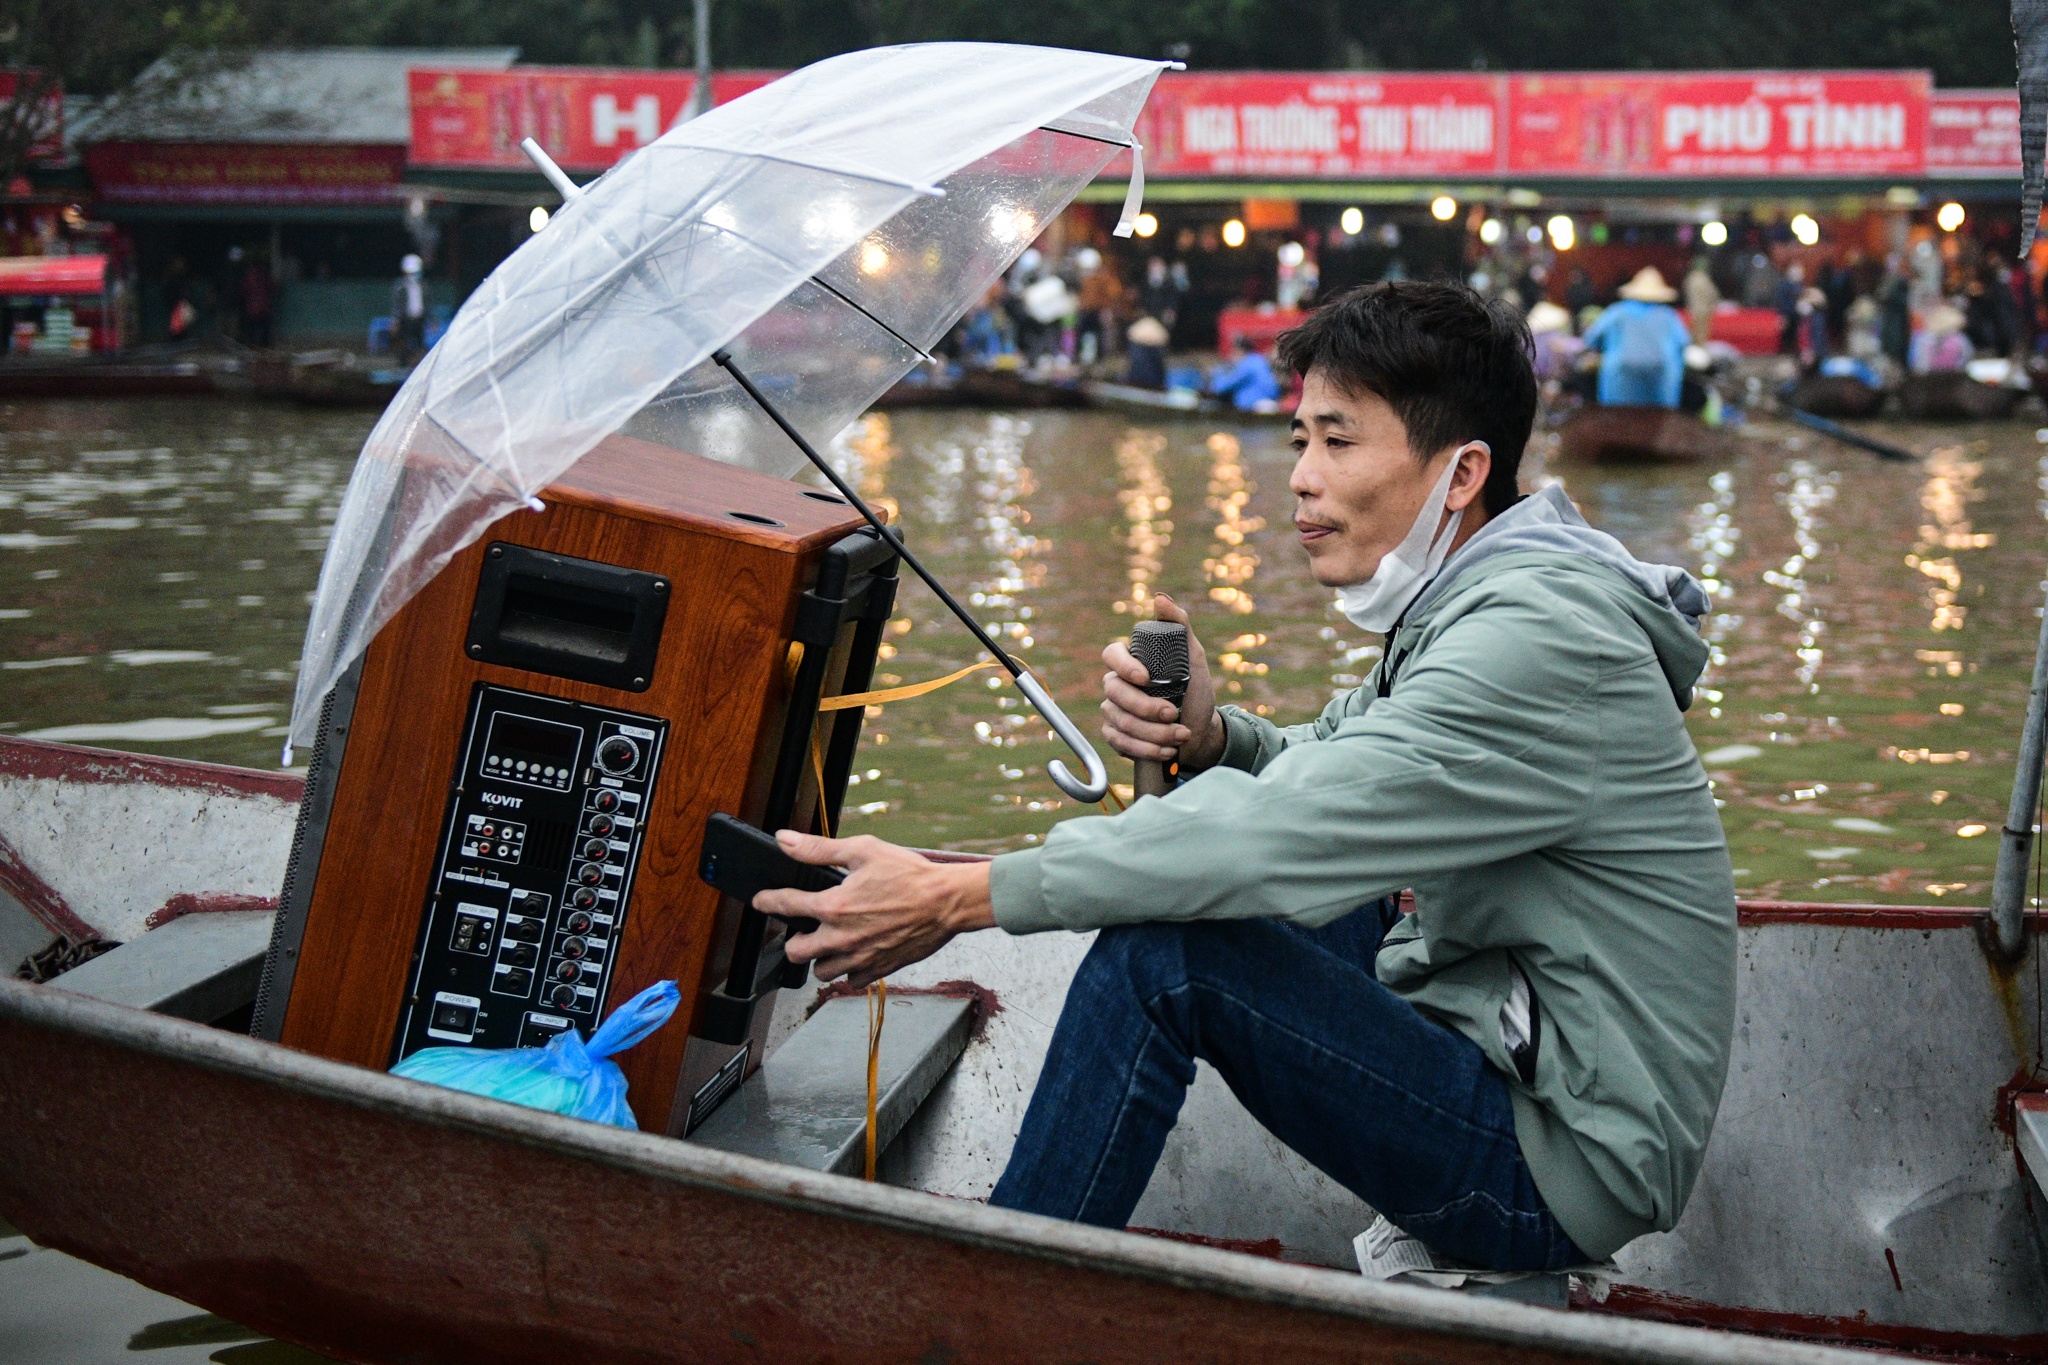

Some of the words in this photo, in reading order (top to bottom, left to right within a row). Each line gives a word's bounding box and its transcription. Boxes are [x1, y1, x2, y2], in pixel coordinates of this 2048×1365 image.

[624, 727, 651, 737] VOLUME
[481, 792, 523, 808] KOVIT
[479, 907, 496, 915] INPUT
[444, 994, 472, 1004] POWER
[545, 1017, 564, 1025] INPUT
